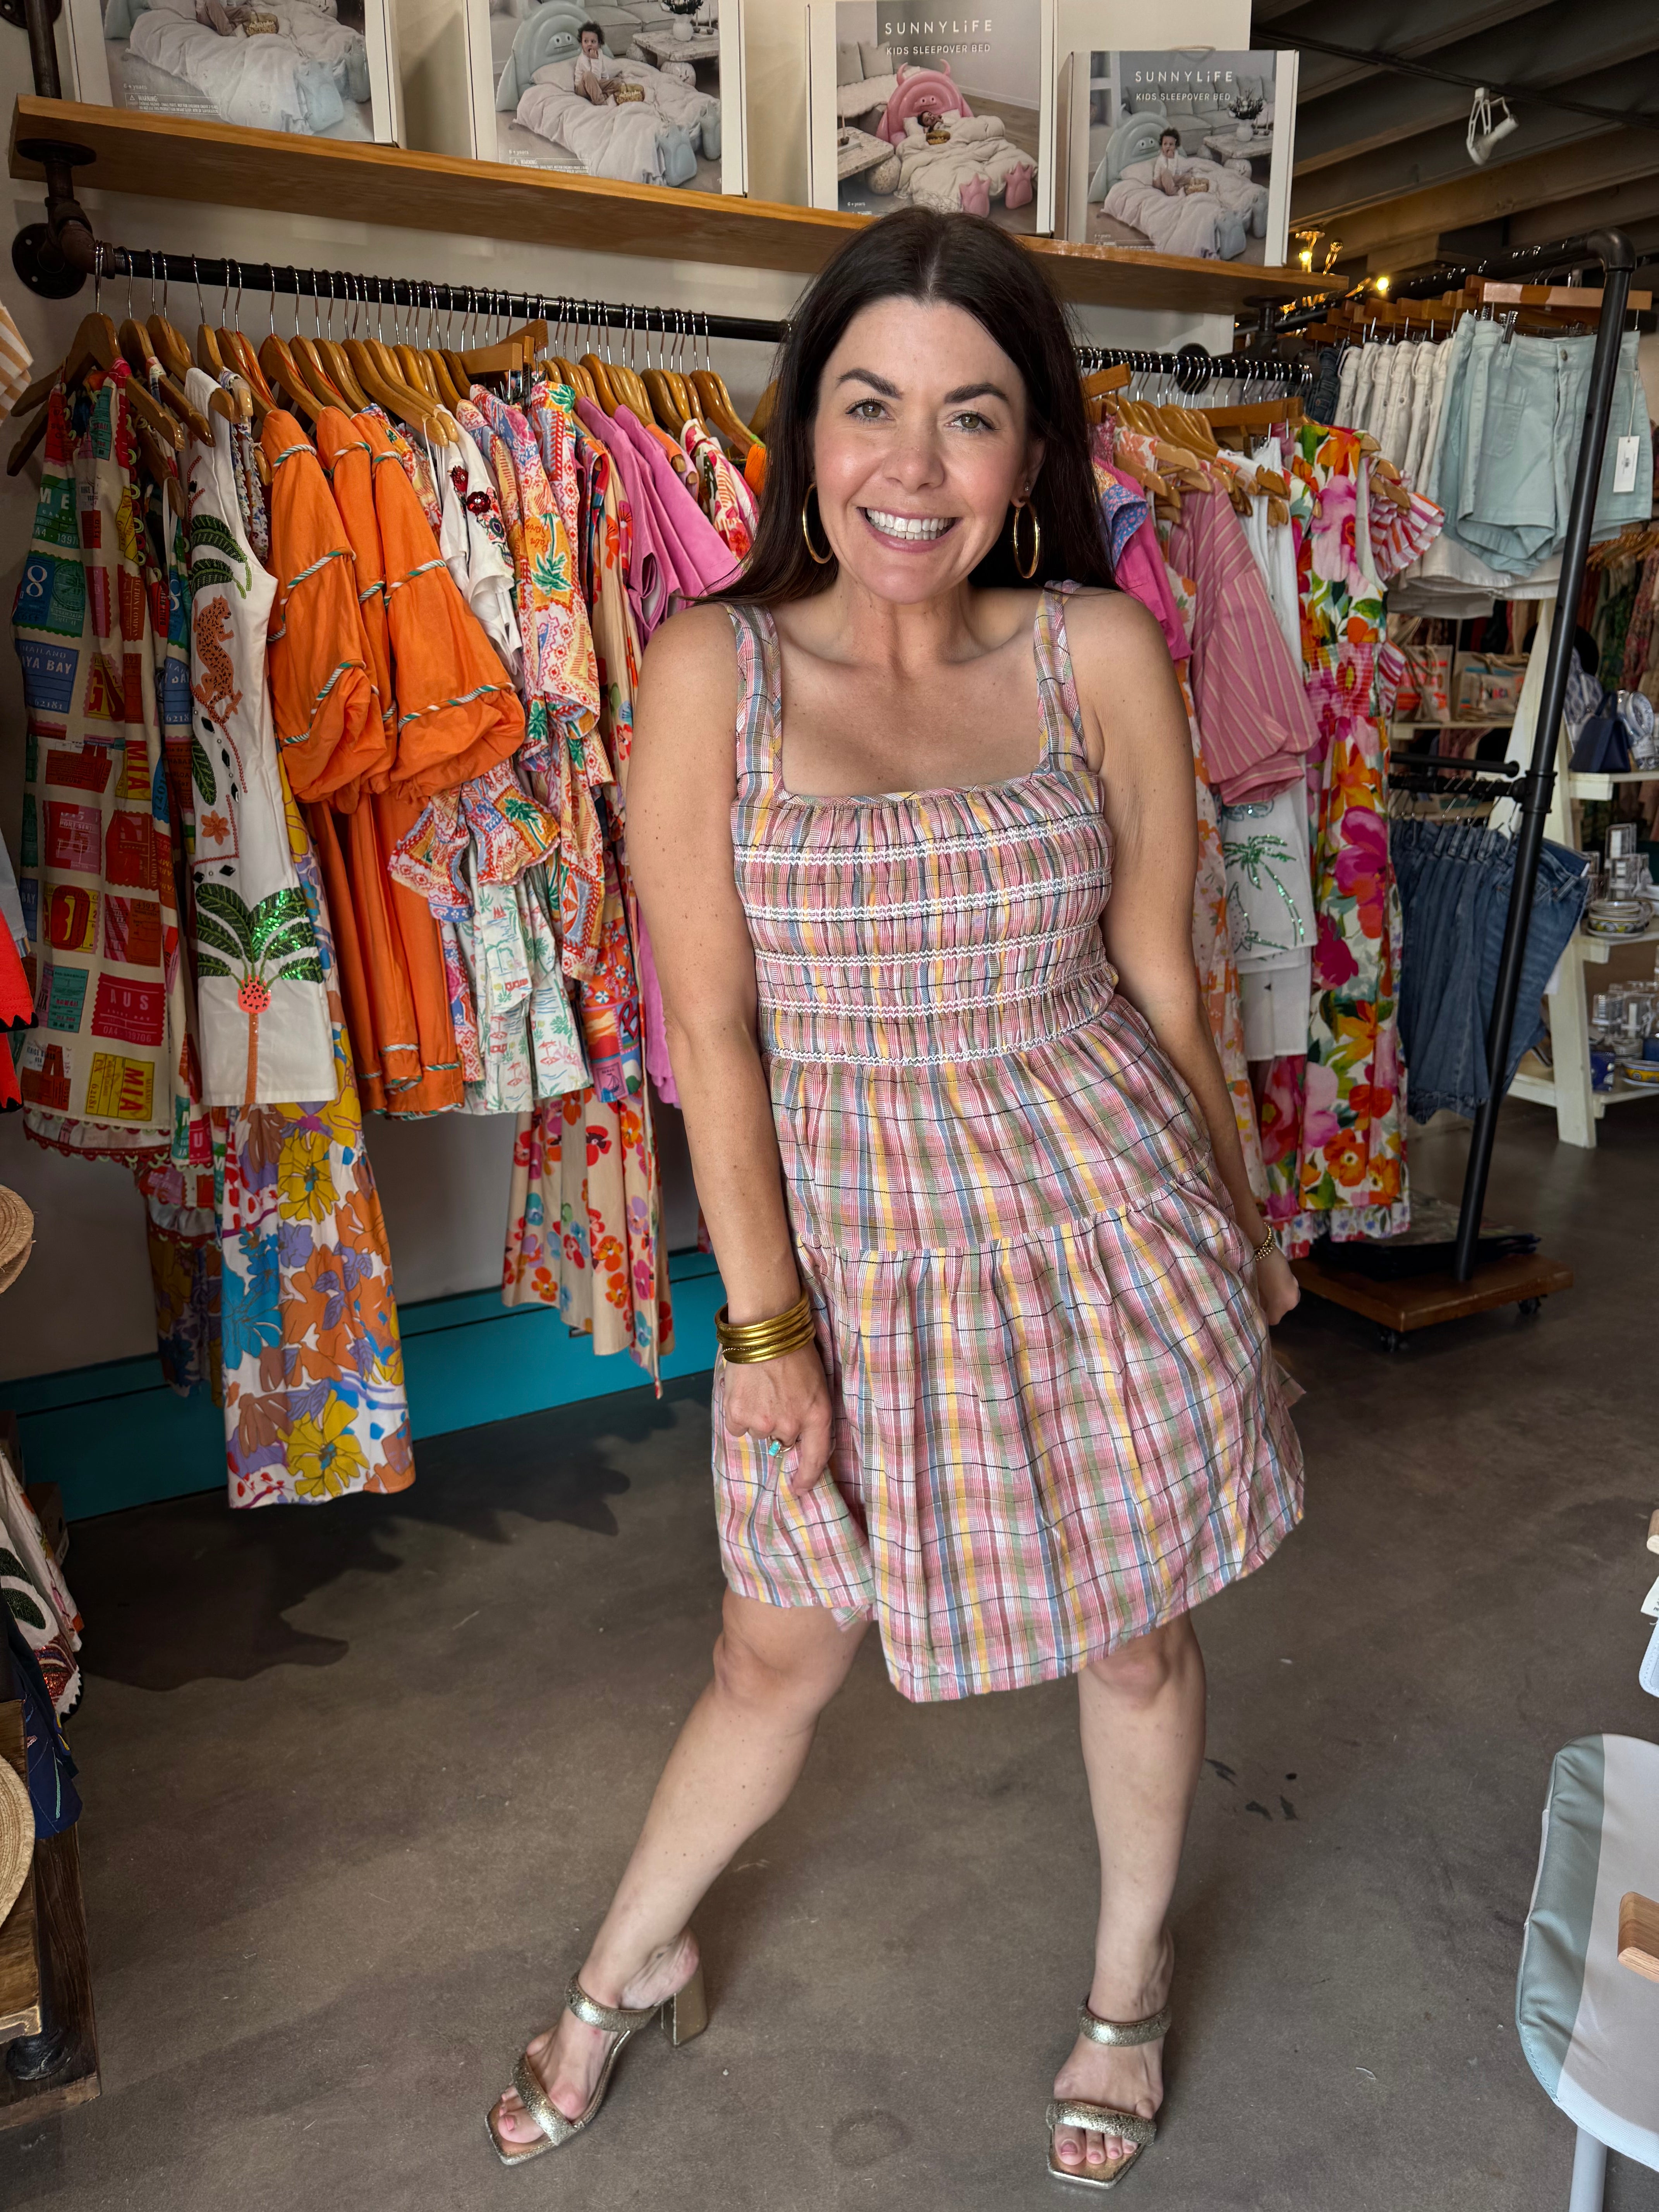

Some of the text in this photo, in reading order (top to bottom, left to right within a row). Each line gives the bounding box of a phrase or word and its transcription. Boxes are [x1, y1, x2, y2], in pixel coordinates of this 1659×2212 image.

[887, 44, 990, 55] KIDS SLEEPOVER BED
[531, 538, 549, 552] Palm
[26, 565, 47, 597] 8
[46, 660, 72, 674] BAY
[35, 698, 63, 711] 62181
[110, 988, 149, 1010] AUS
[119, 1066, 144, 1111] MIA
